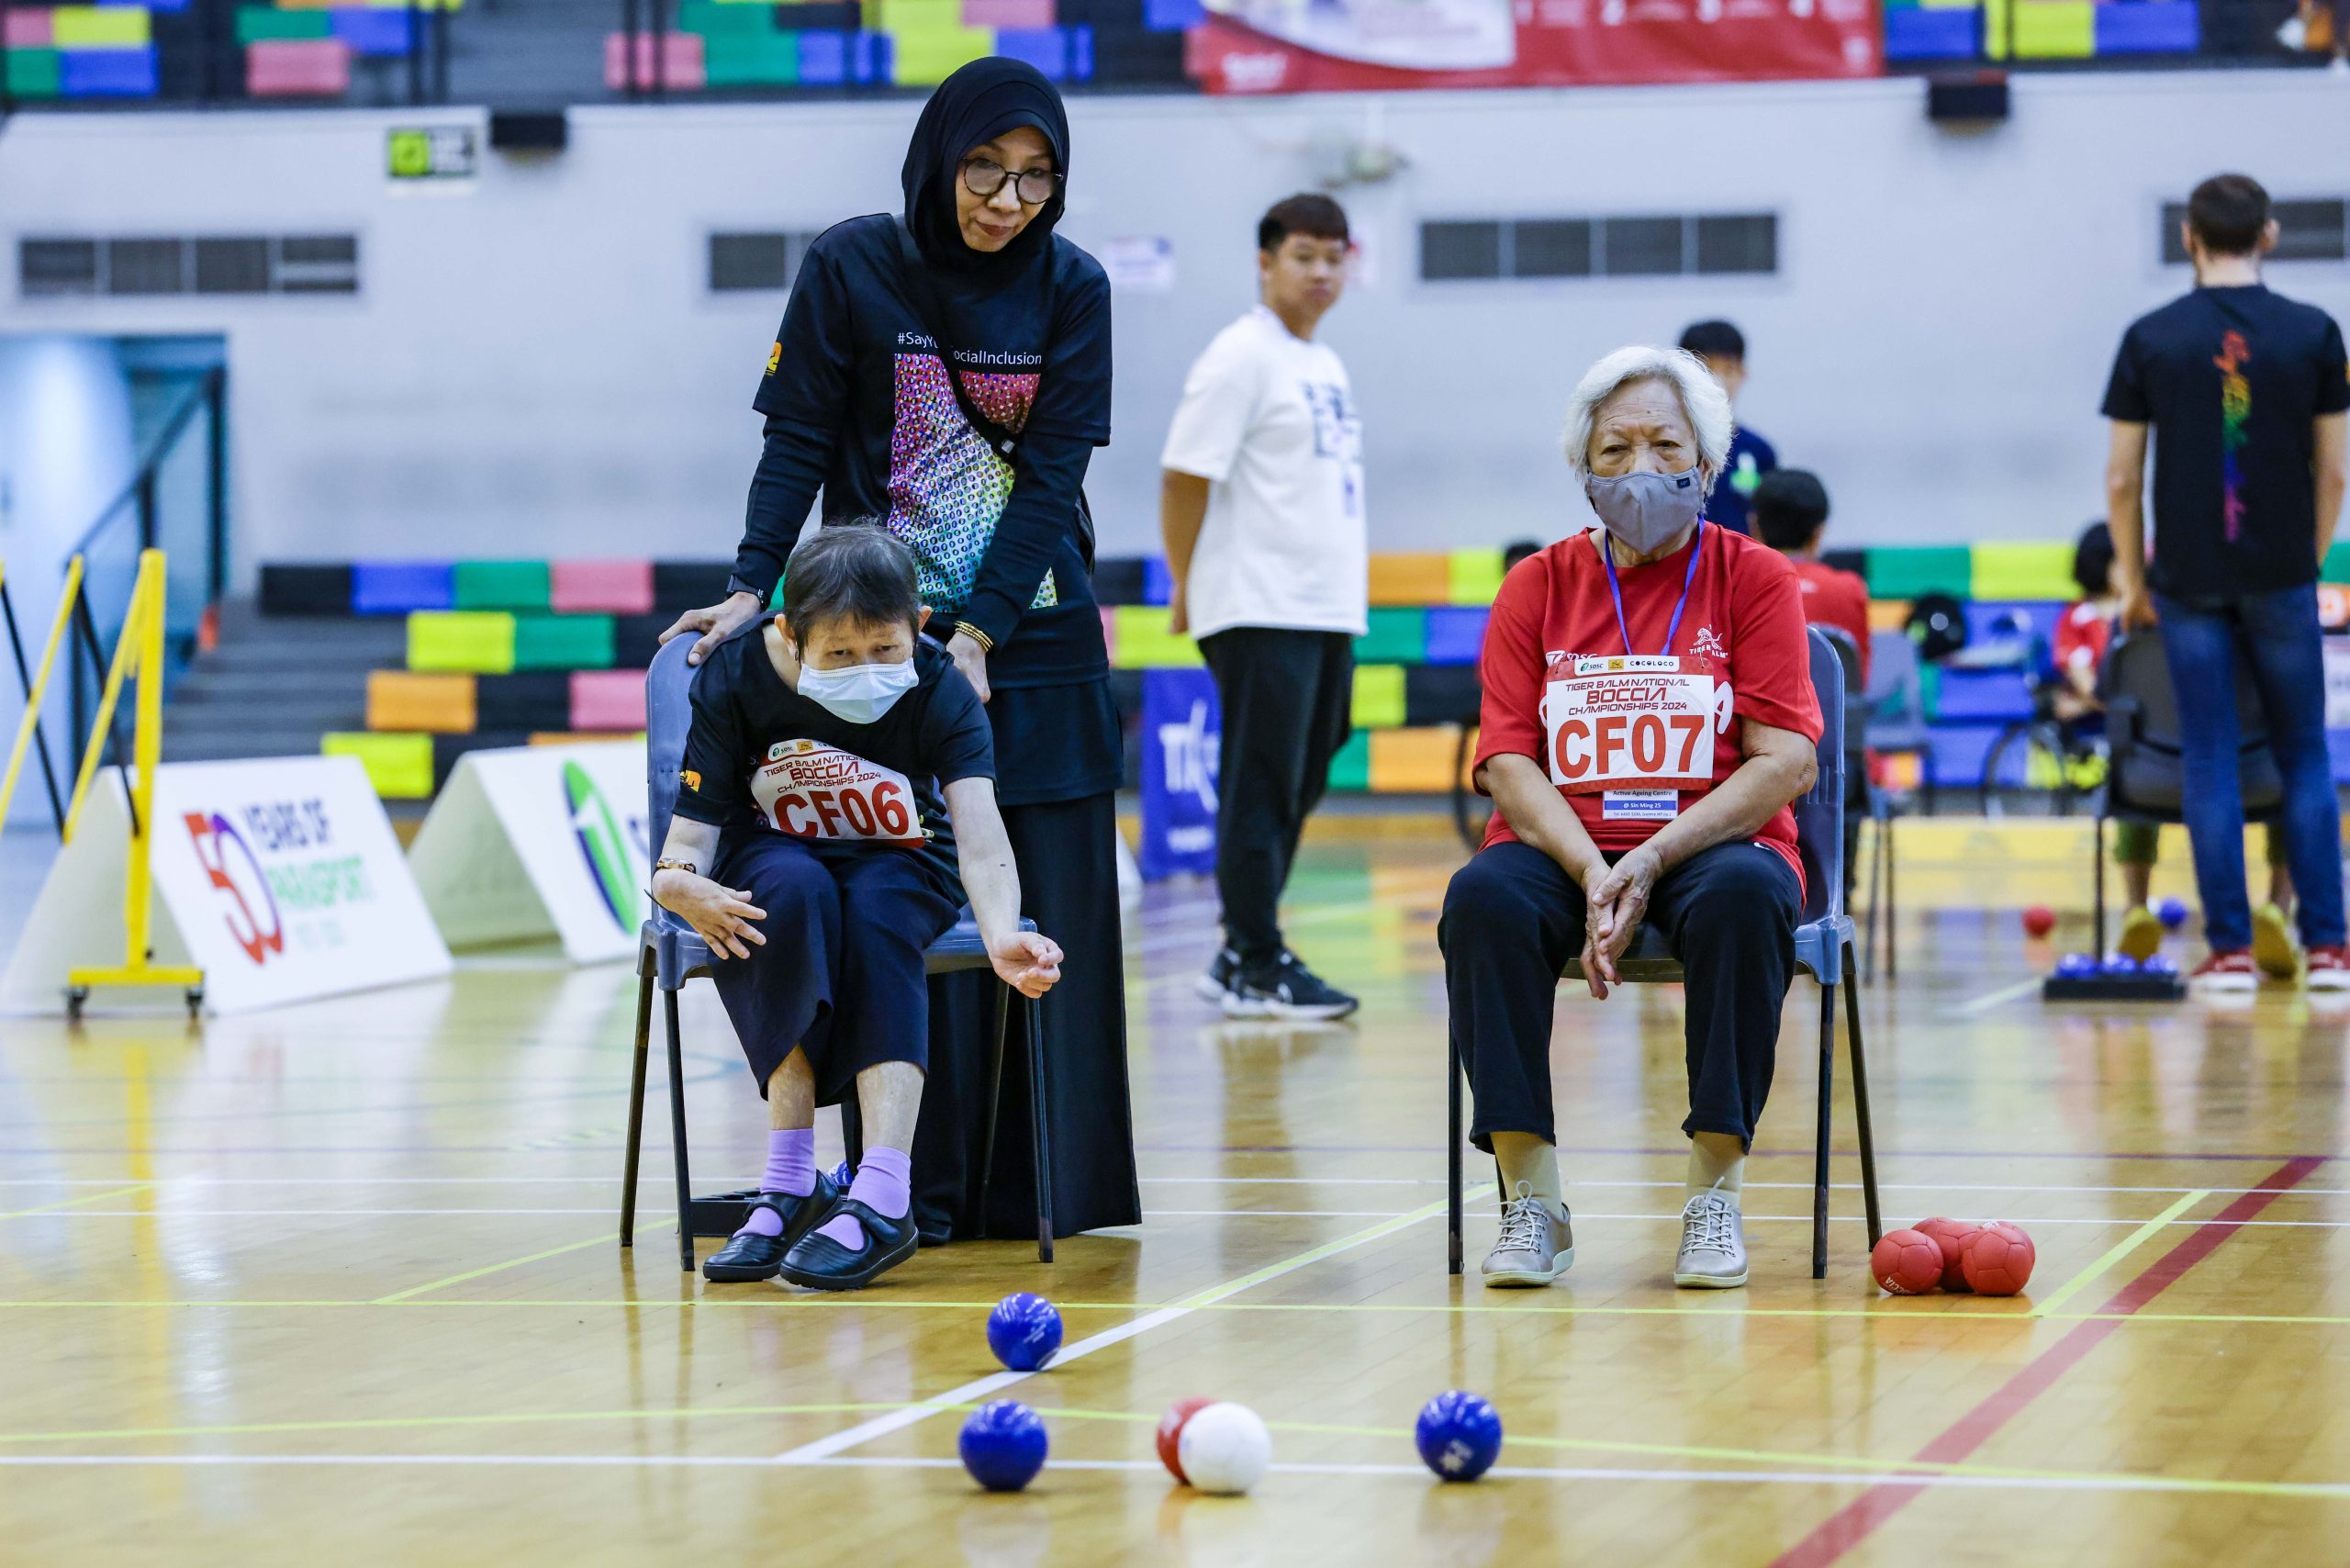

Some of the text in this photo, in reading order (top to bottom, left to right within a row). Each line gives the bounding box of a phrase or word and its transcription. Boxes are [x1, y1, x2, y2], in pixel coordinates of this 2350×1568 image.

[1566, 678, 1690, 691] TIGER BALM NATIONAL
[1586, 687, 1666, 704] BOCCIA
[1569, 701, 1687, 715] CHAMPIONSHIPS 2024
[1555, 713, 1705, 779] CF07
[764, 754, 867, 778] TIGER BALM NATION
[789, 761, 859, 780] BOCCIA
[778, 771, 881, 793] CHAMPIONSHIPS 2024
[774, 780, 910, 838] CF06
